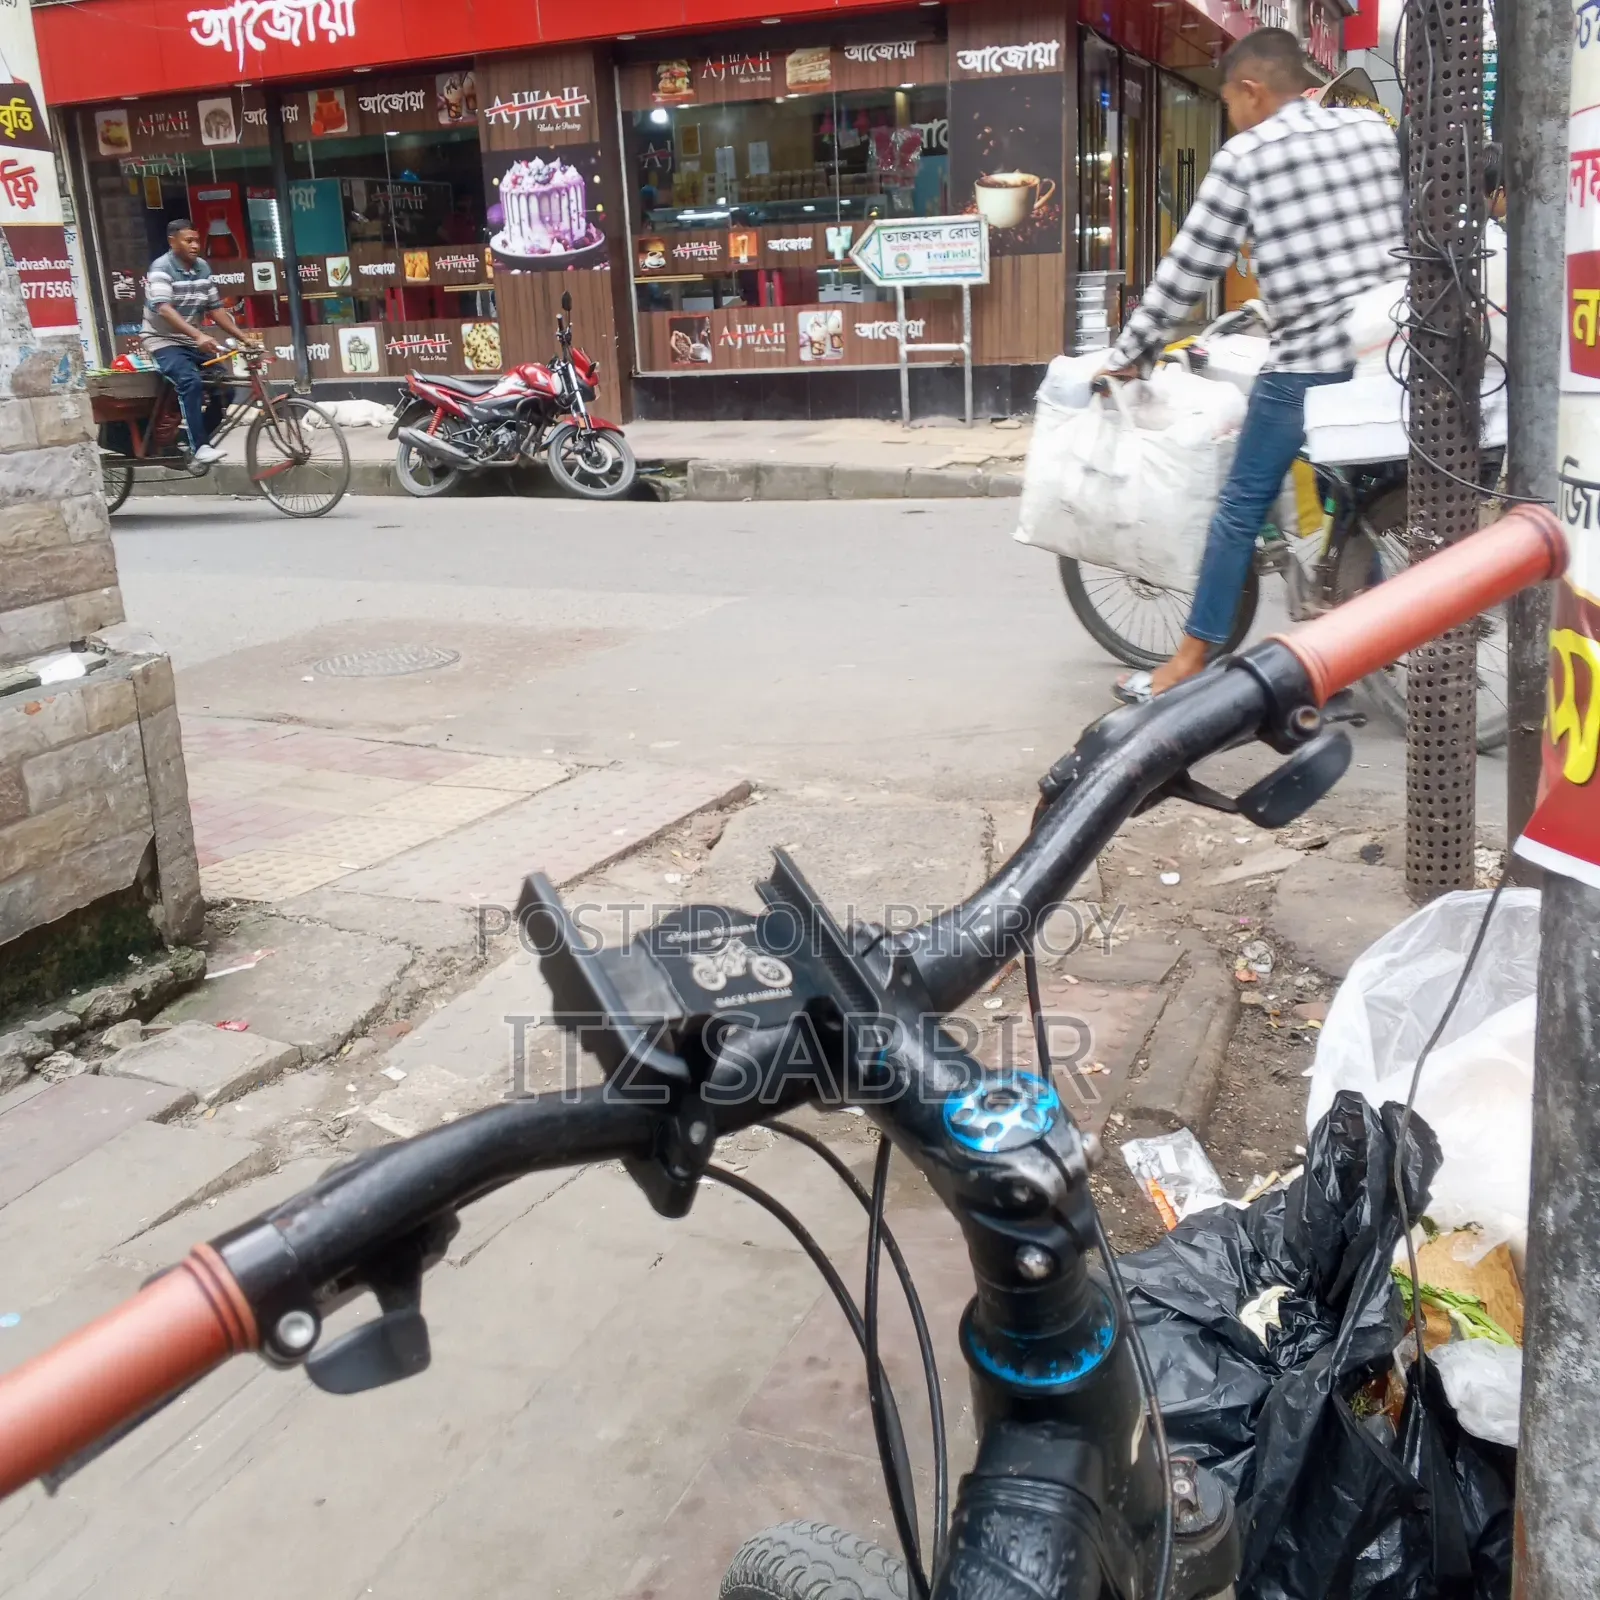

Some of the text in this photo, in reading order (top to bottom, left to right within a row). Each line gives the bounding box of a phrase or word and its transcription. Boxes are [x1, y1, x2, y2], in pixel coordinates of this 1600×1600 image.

[844, 40, 916, 62] আজোয়া
[956, 39, 1060, 73] আজোয়া
[702, 51, 772, 81] AJWAH
[358, 89, 426, 114] আজোয়া
[484, 86, 590, 131] AJWAH
[136, 110, 190, 137] AJWAH
[767, 237, 813, 252] আজোয়া
[883, 226, 981, 243] তাজমহল রোড
[435, 254, 479, 271] AJWAH
[672, 241, 722, 260] AJWAH
[359, 262, 396, 276] আজোয়া
[385, 333, 452, 359] AJWAH
[718, 322, 791, 349] AJWAH
